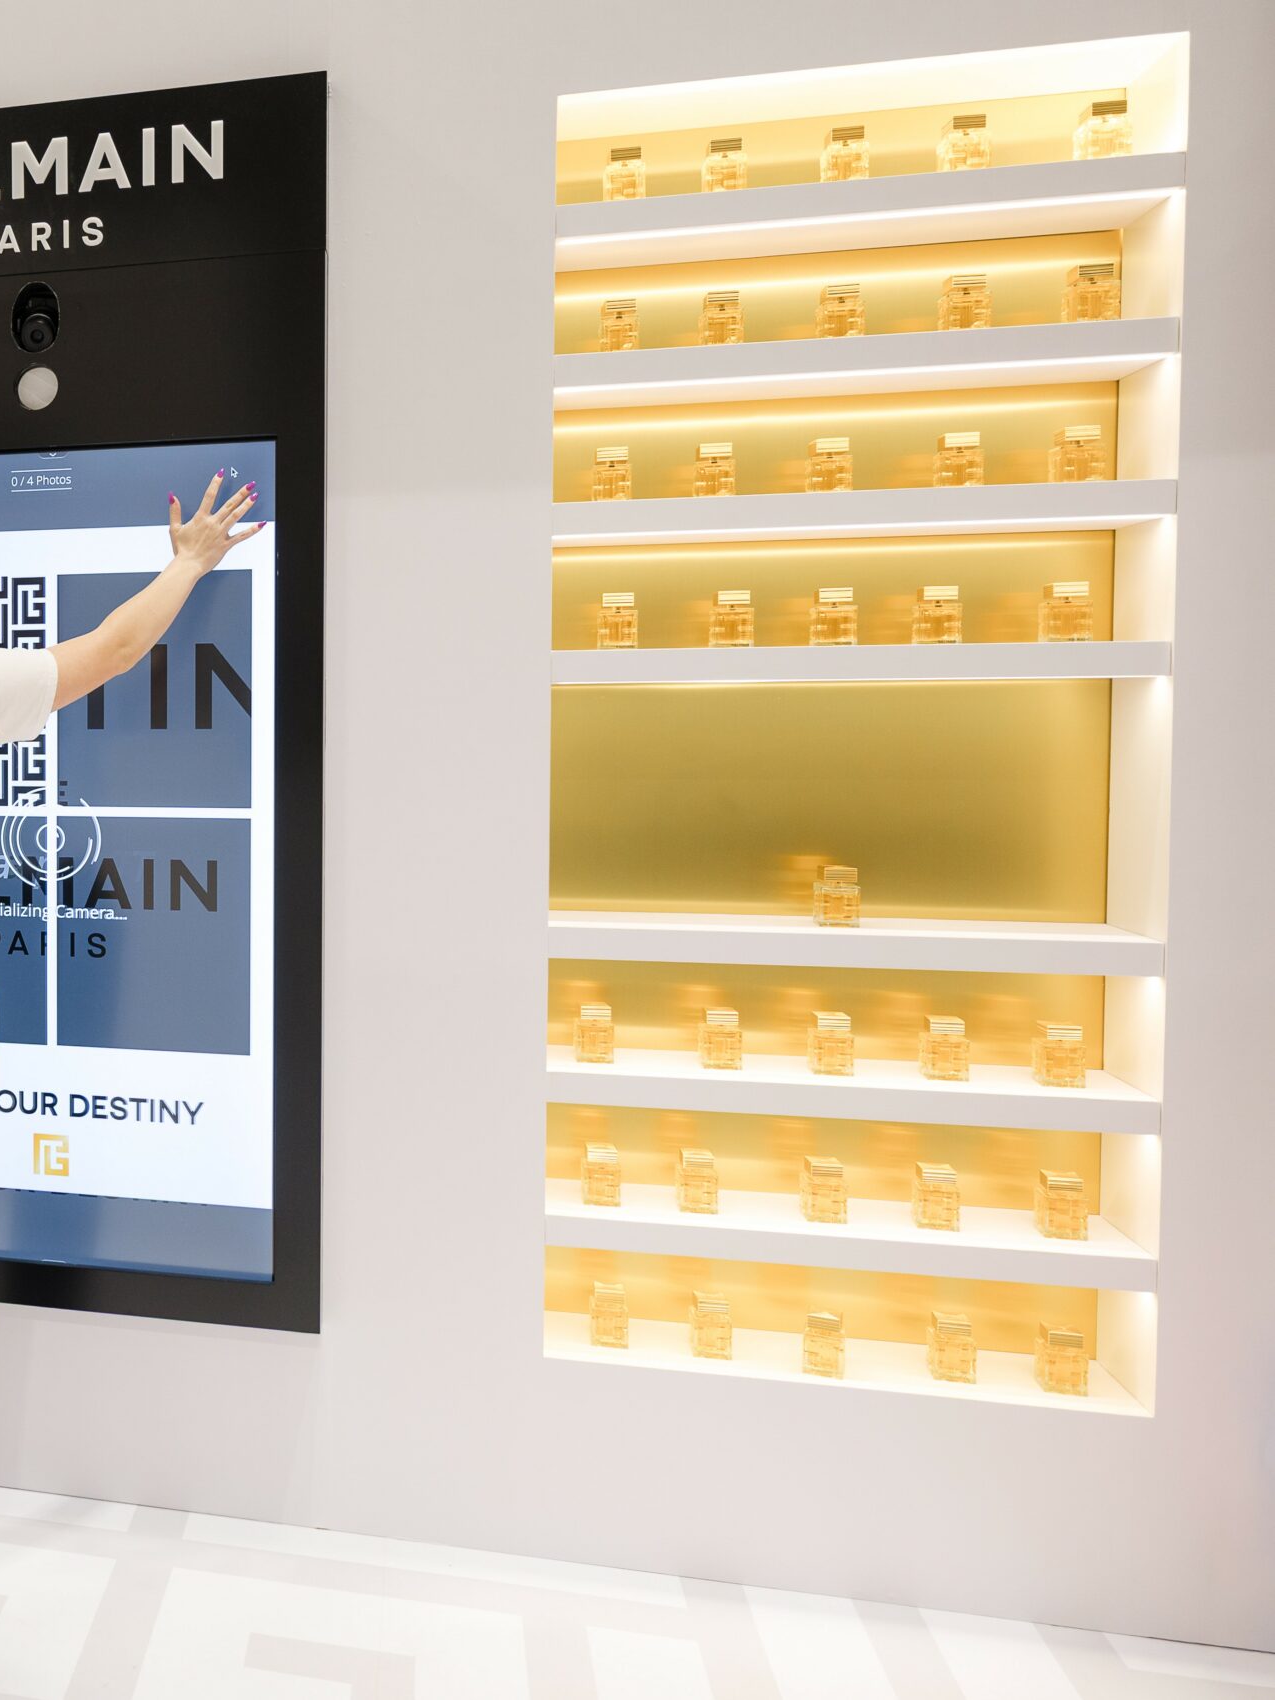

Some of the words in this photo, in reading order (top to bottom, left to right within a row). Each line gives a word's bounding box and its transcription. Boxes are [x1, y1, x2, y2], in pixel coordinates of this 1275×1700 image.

[11, 476, 18, 487] 0
[27, 475, 34, 486] 4
[36, 474, 72, 486] Photos
[69, 1093, 204, 1125] DESTINY
